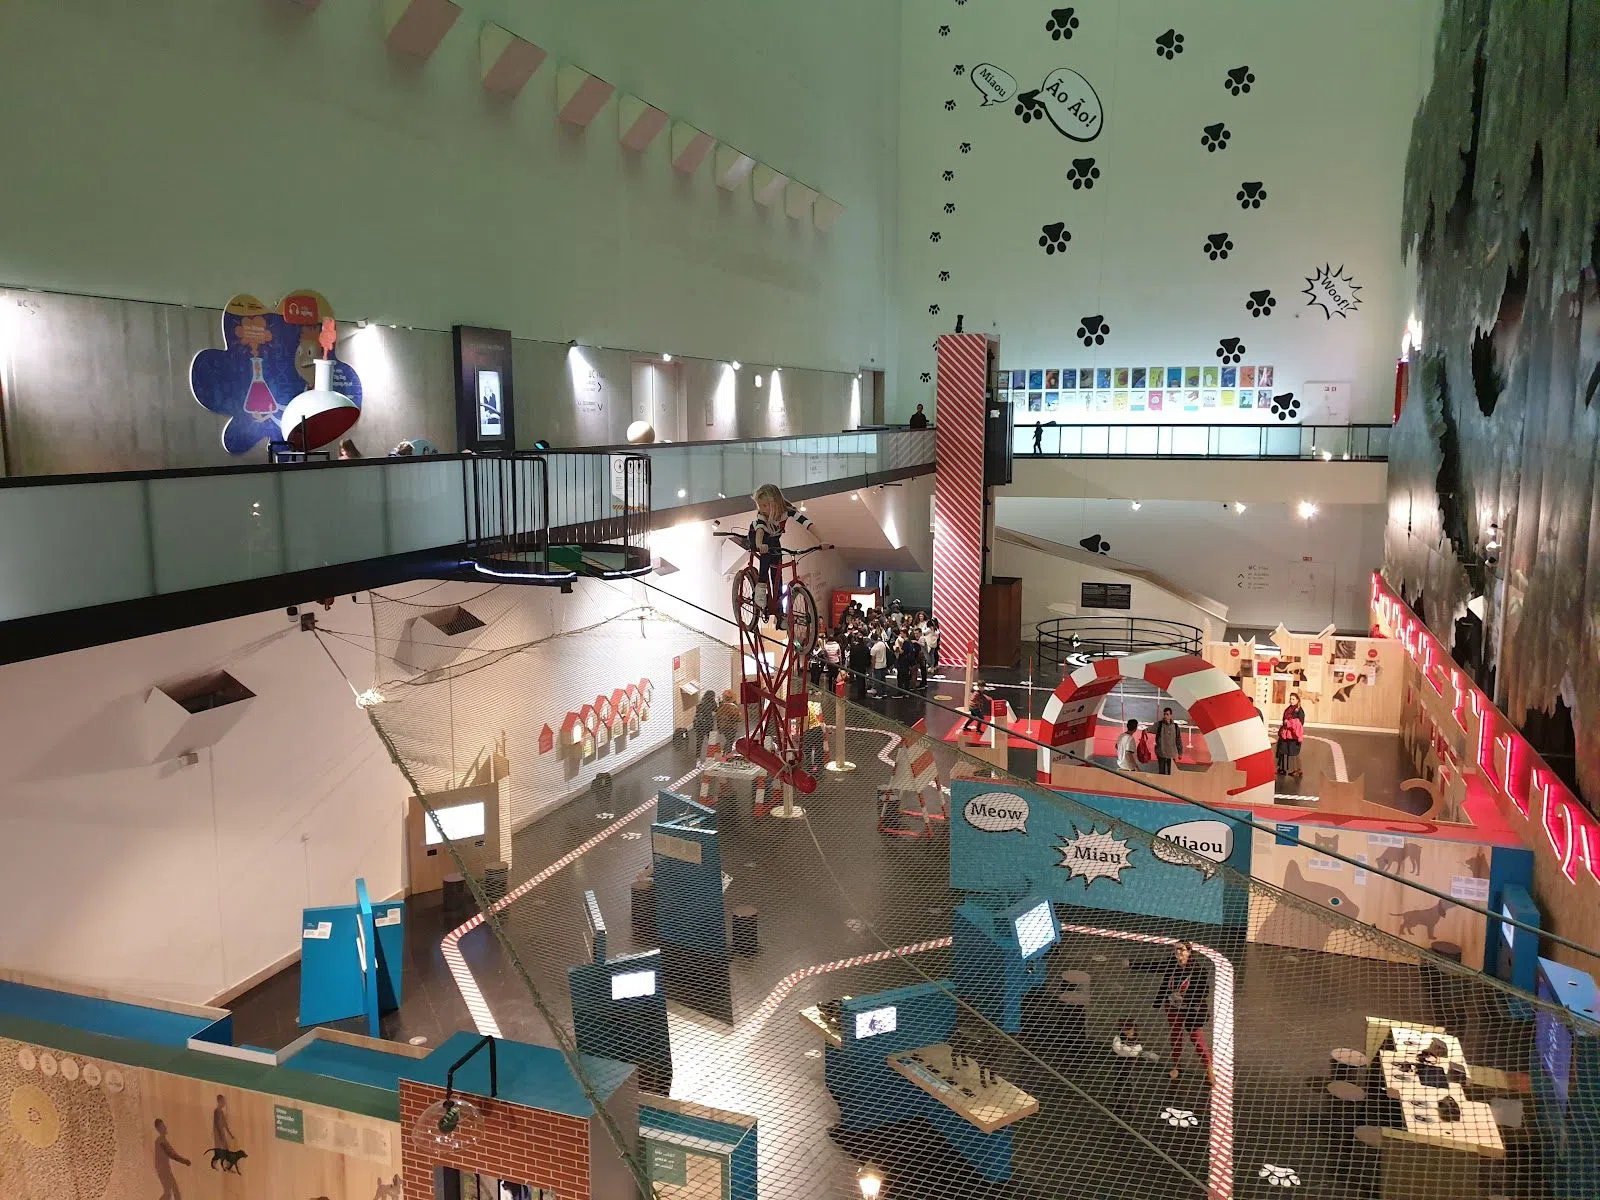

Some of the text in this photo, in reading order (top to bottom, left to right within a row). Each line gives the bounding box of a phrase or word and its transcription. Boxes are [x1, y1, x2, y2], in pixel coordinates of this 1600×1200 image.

[979, 68, 1006, 97] Miaou
[1046, 78, 1097, 128] Ão Ão!
[1321, 276, 1350, 310] Woof!
[970, 803, 1022, 820] Meow
[1074, 846, 1121, 864] Miau
[1164, 834, 1223, 854] Miaou
